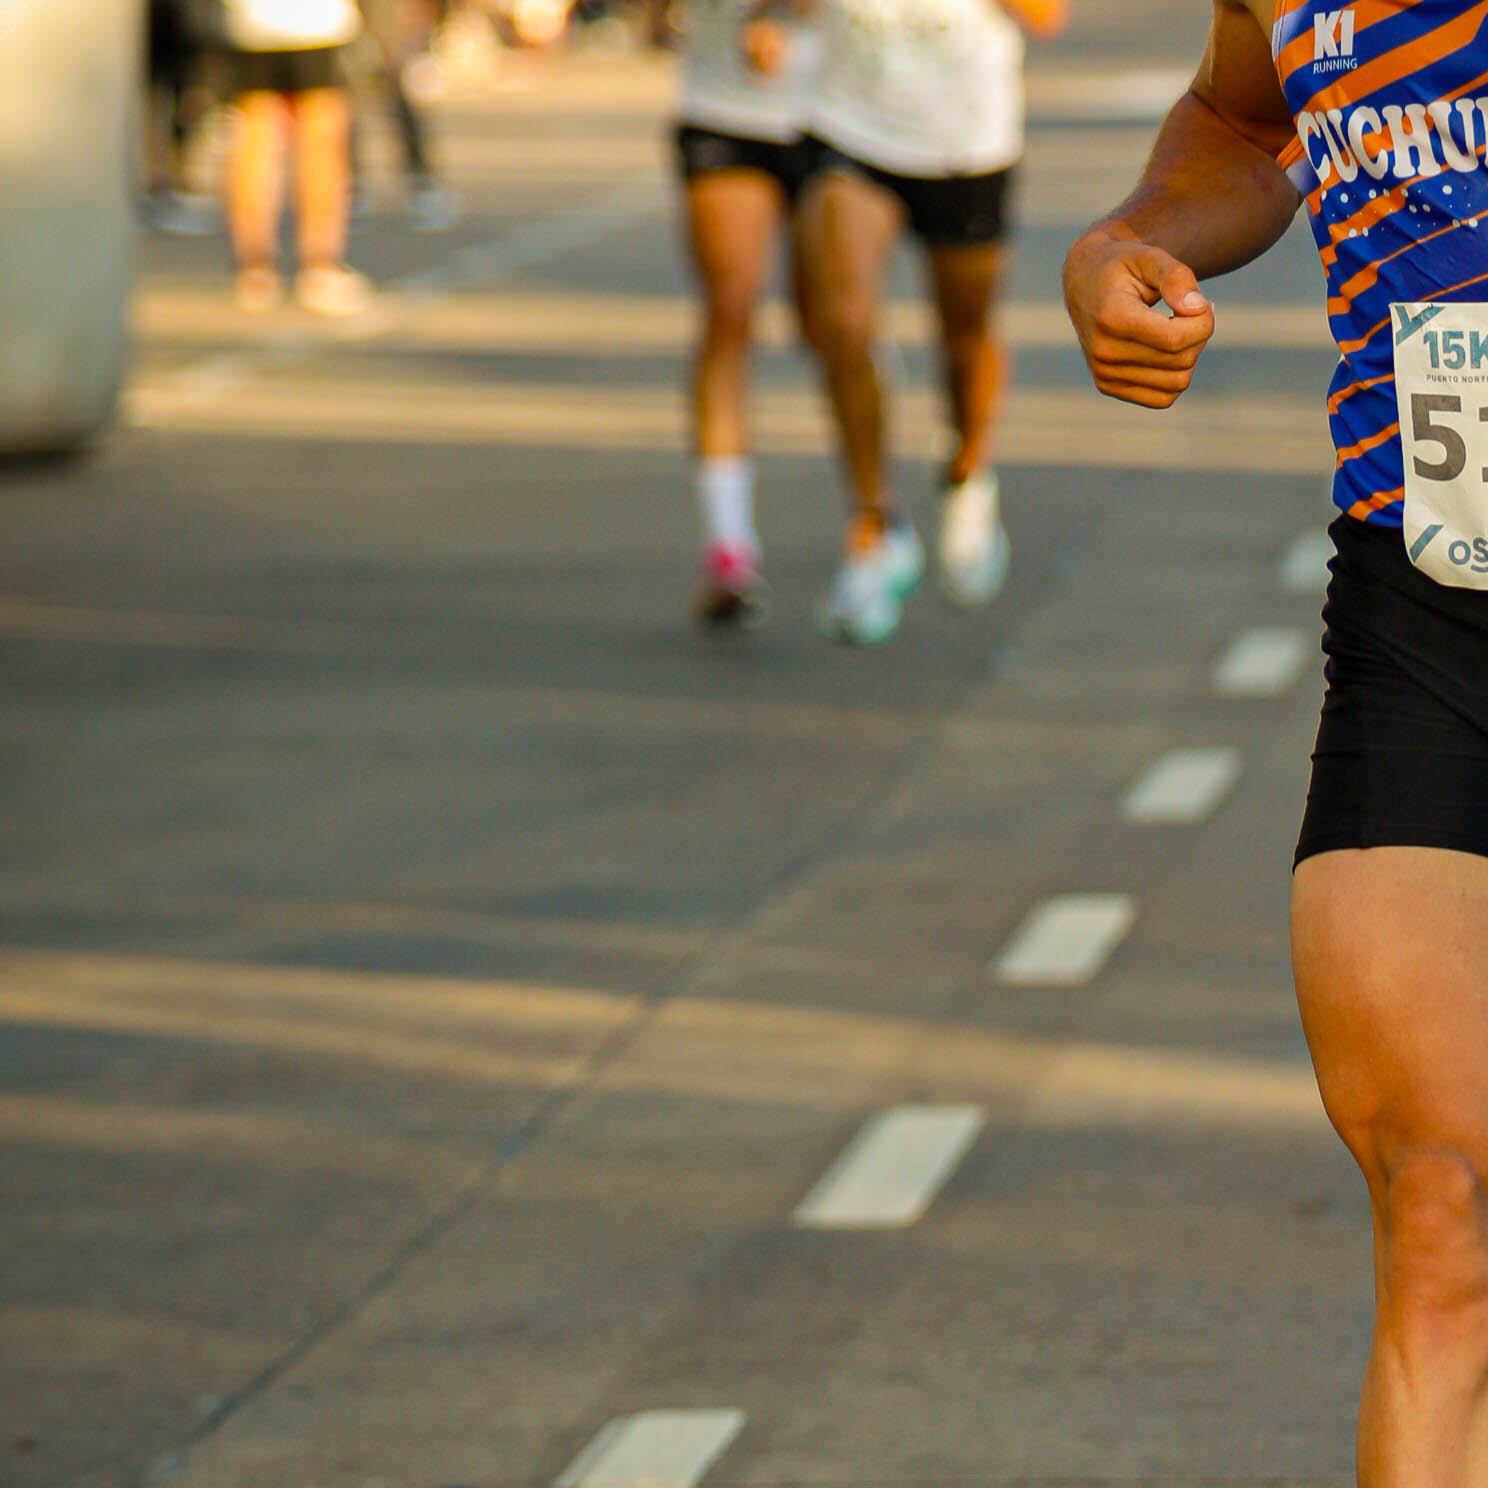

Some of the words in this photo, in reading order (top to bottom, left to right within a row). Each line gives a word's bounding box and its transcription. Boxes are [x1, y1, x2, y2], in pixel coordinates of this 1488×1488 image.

[1313, 9, 1355, 60] K1
[1313, 57, 1358, 75] RUNNING
[1425, 374, 1459, 384] PUERTO
